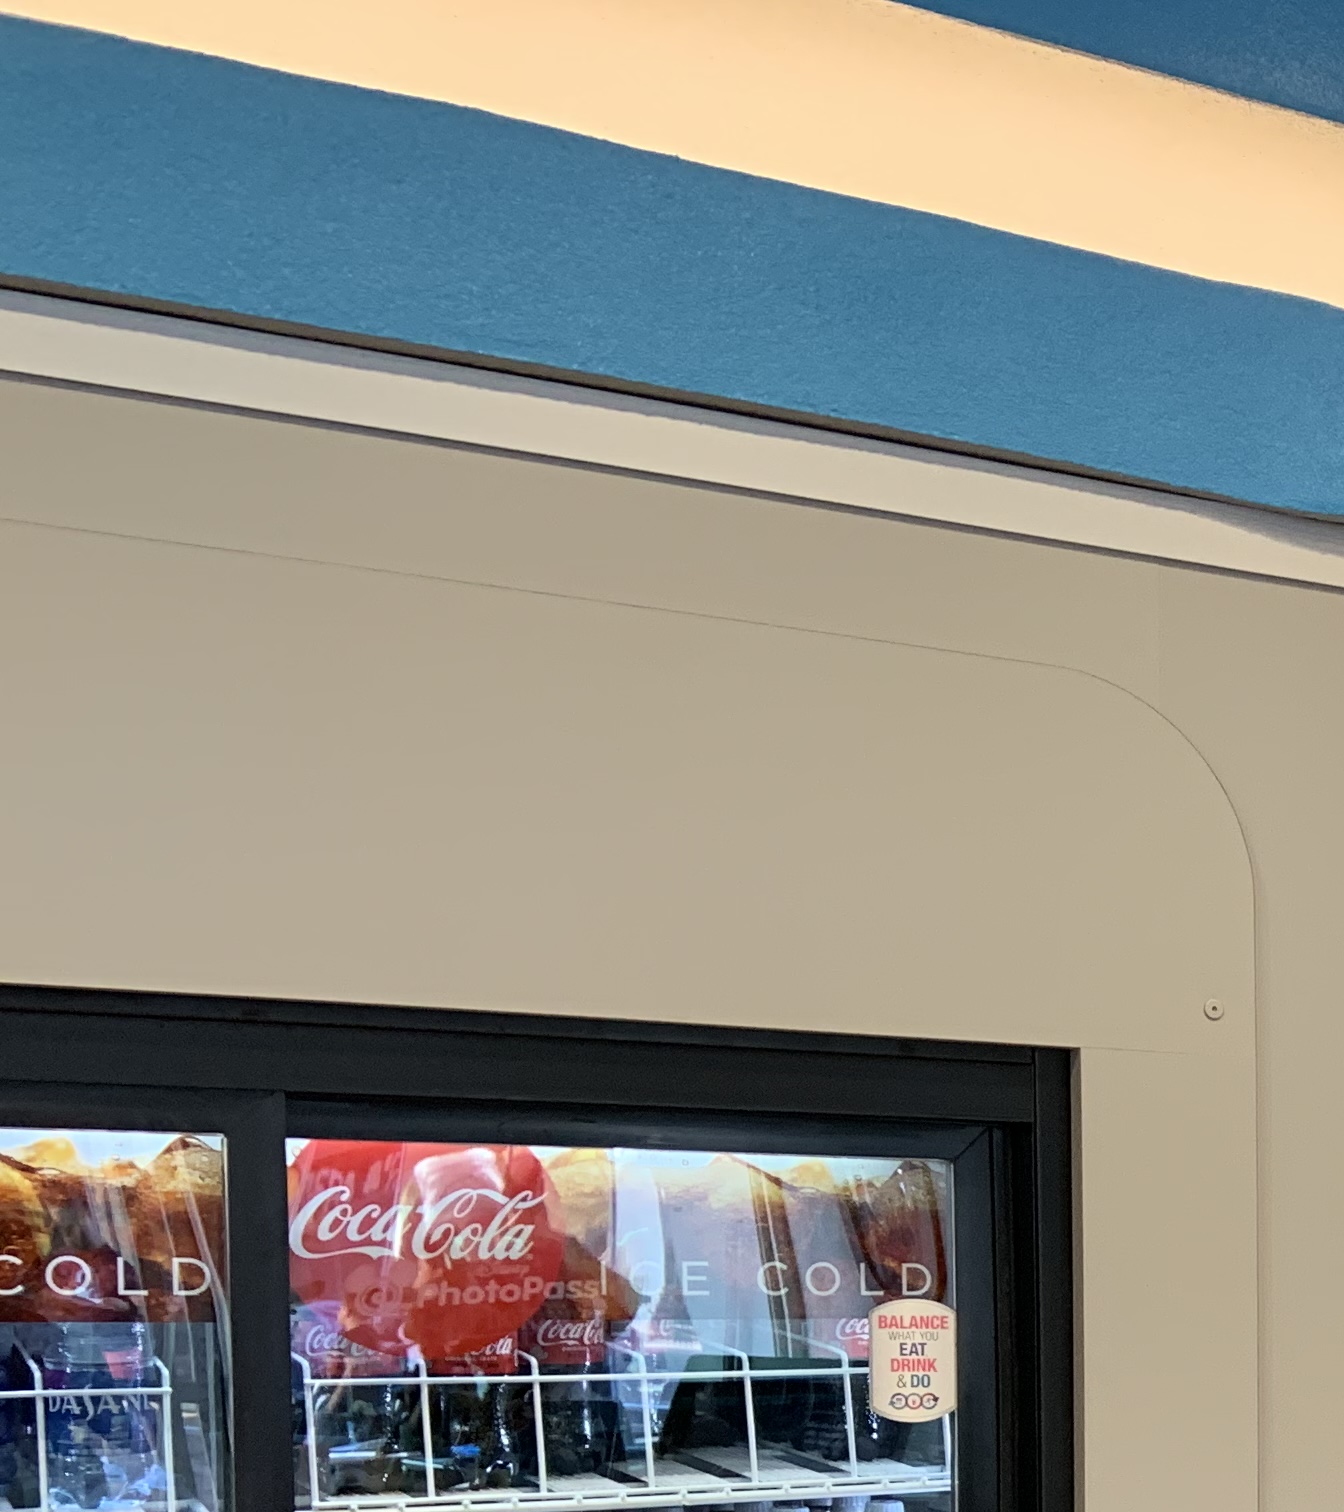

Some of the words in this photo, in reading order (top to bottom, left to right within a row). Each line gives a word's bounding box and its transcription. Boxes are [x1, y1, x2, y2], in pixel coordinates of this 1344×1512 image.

[600, 1260, 710, 1297] ICE
[756, 1261, 933, 1297] COLD
[877, 1314, 950, 1330] BALANCE
[888, 1331, 917, 1342] WHAT
[918, 1331, 939, 1342] YOU
[899, 1342, 926, 1356] EAT
[890, 1358, 938, 1373] DRINK
[896, 1374, 907, 1388] &
[910, 1374, 931, 1388] DO
